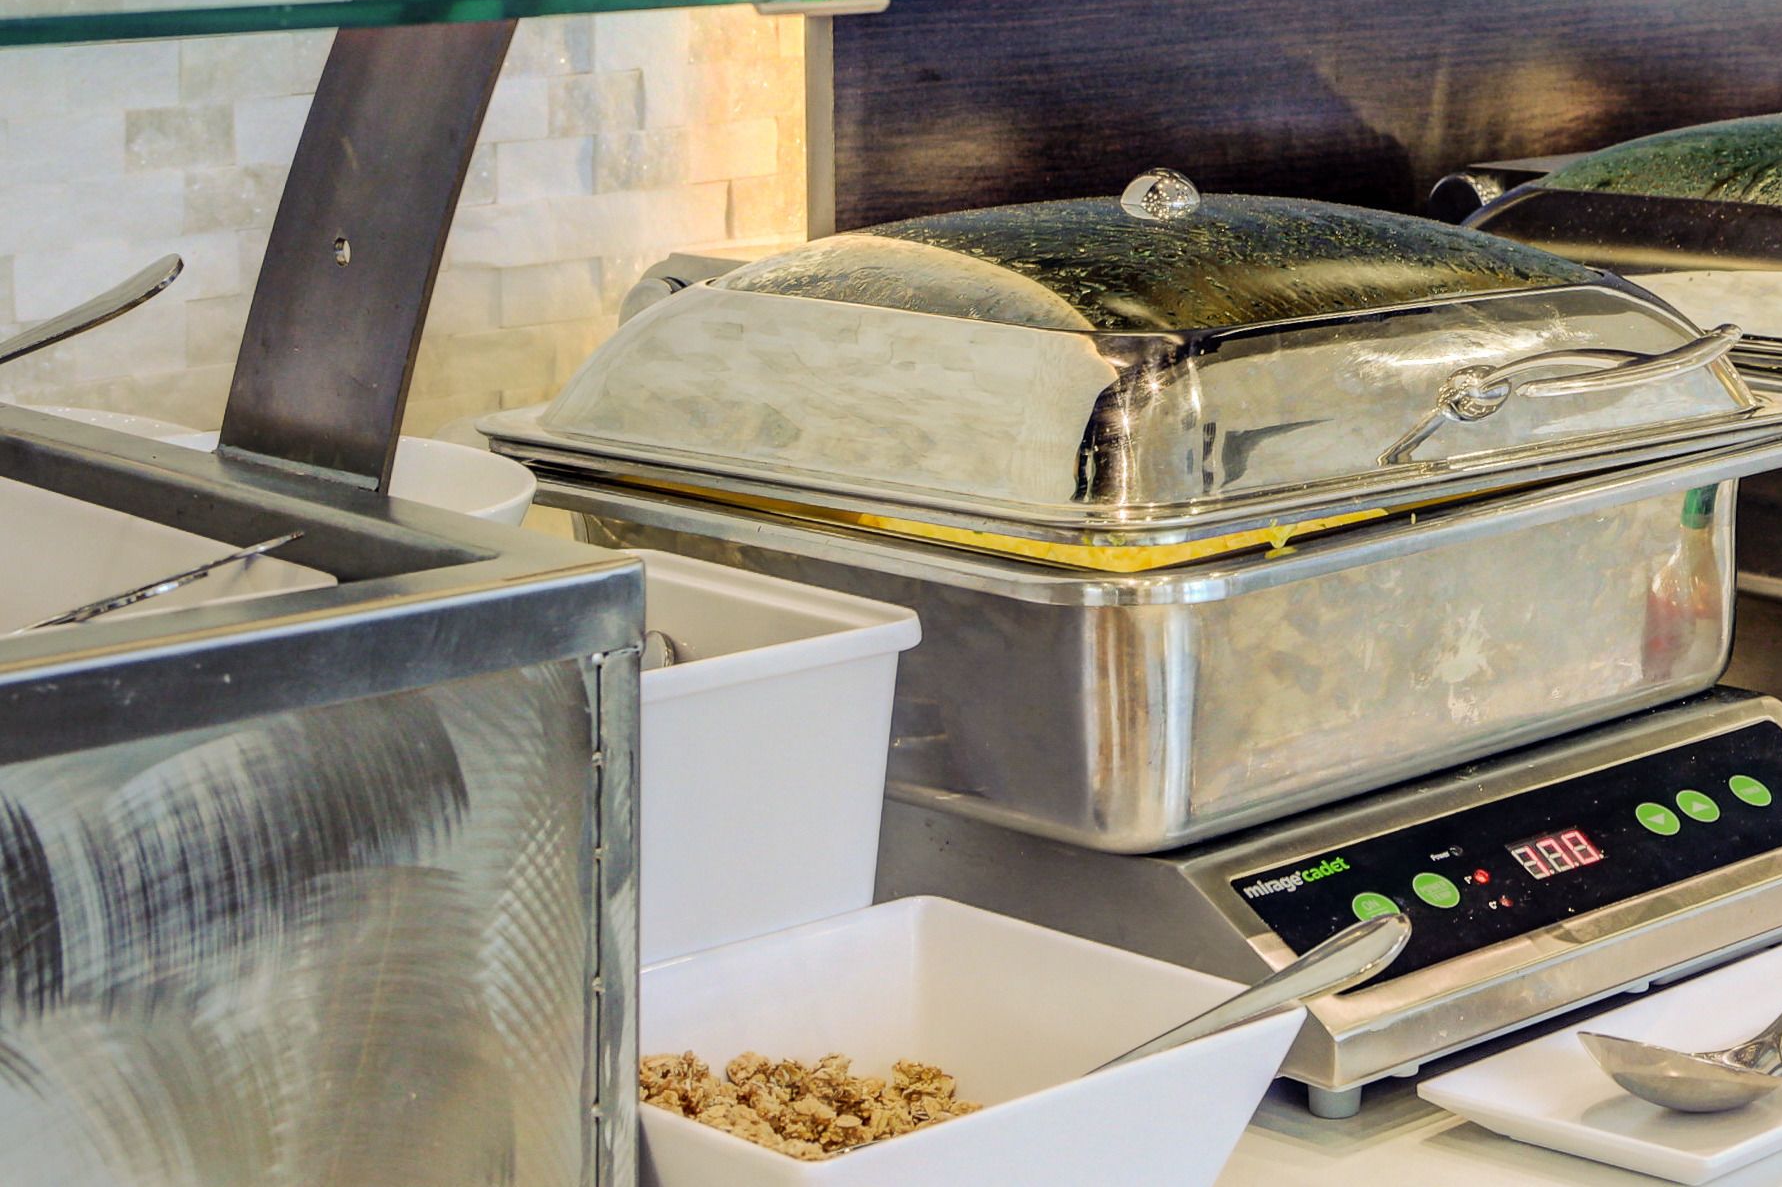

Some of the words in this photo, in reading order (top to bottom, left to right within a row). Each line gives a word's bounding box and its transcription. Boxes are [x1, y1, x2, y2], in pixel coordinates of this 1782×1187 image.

[1243, 870, 1304, 899] mirage
[1302, 856, 1350, 882] cadet
[1361, 899, 1380, 912] ON
